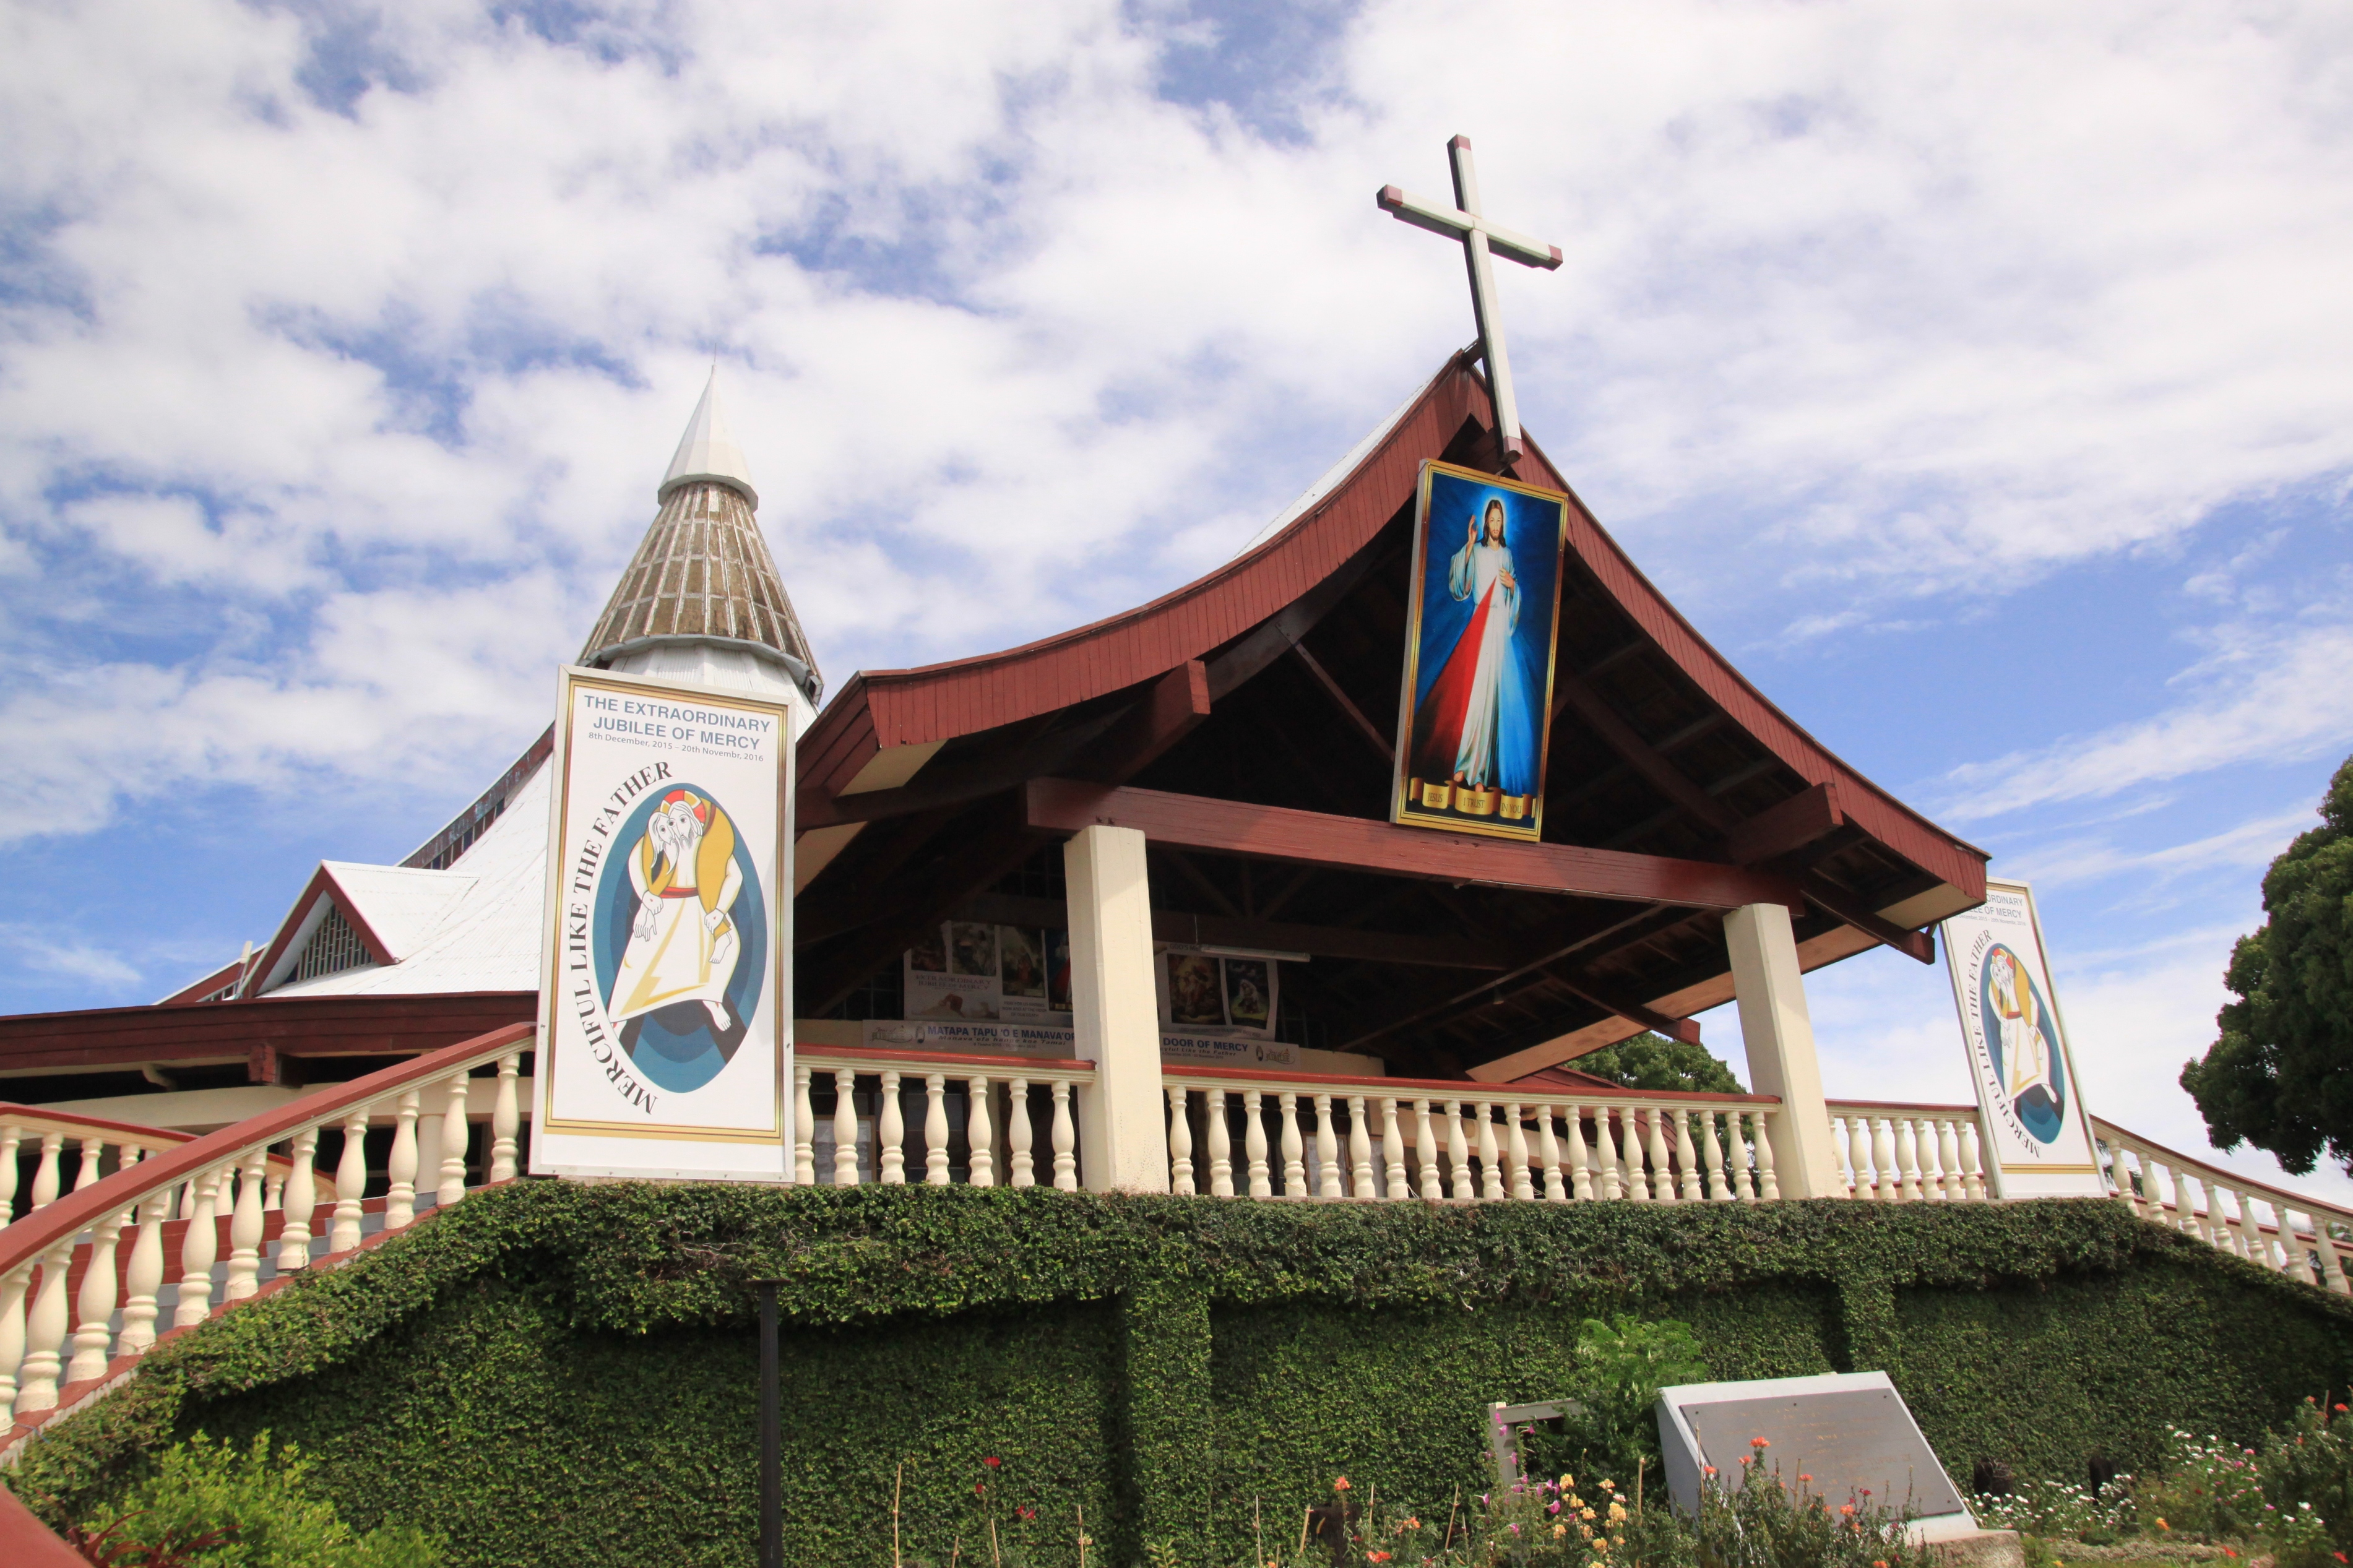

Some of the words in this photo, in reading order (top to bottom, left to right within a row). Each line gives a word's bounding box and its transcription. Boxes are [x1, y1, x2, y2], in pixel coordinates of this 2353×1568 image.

[584, 695, 618, 712] THE
[624, 700, 771, 733] EXTRAORDINARY
[589, 731, 603, 740] 8th
[605, 734, 650, 747] December,
[652, 741, 673, 750] 2015
[681, 744, 700, 754] 20th
[702, 747, 741, 760] Novembr,
[743, 752, 764, 762] 2016
[593, 717, 667, 738] JUBILEE
[672, 726, 695, 741] OF
[701, 730, 760, 750] MERCY
[592, 761, 673, 838] FATHER
[1427, 793, 1443, 803] JESUS
[1463, 798, 1466, 806] I
[1467, 798, 1485, 808] TRUST
[1501, 803, 1508, 812] IN
[1509, 804, 1522, 814] YOU
[573, 839, 602, 894] THE
[1984, 906, 1994, 915] OF
[1996, 907, 2021, 918] MERCY
[1986, 894, 2023, 906] ORDINARY
[569, 903, 588, 971] LIKE
[1969, 929, 1992, 981] FATHER
[916, 975, 991, 984] EXTRAORDINARY
[1969, 984, 1979, 1020] THE
[574, 980, 658, 1115] MERCIFUL
[928, 1026, 969, 1036] MATAPA
[971, 1027, 997, 1037] TAPU
[1012, 1030, 1018, 1038] E
[1163, 1038, 1194, 1047] DOOR
[1196, 1040, 1210, 1048] OF
[1213, 1041, 1248, 1052] MERCY
[1973, 1025, 1990, 1069] LIKE
[1988, 1074, 2040, 1158] MERCIFUL
